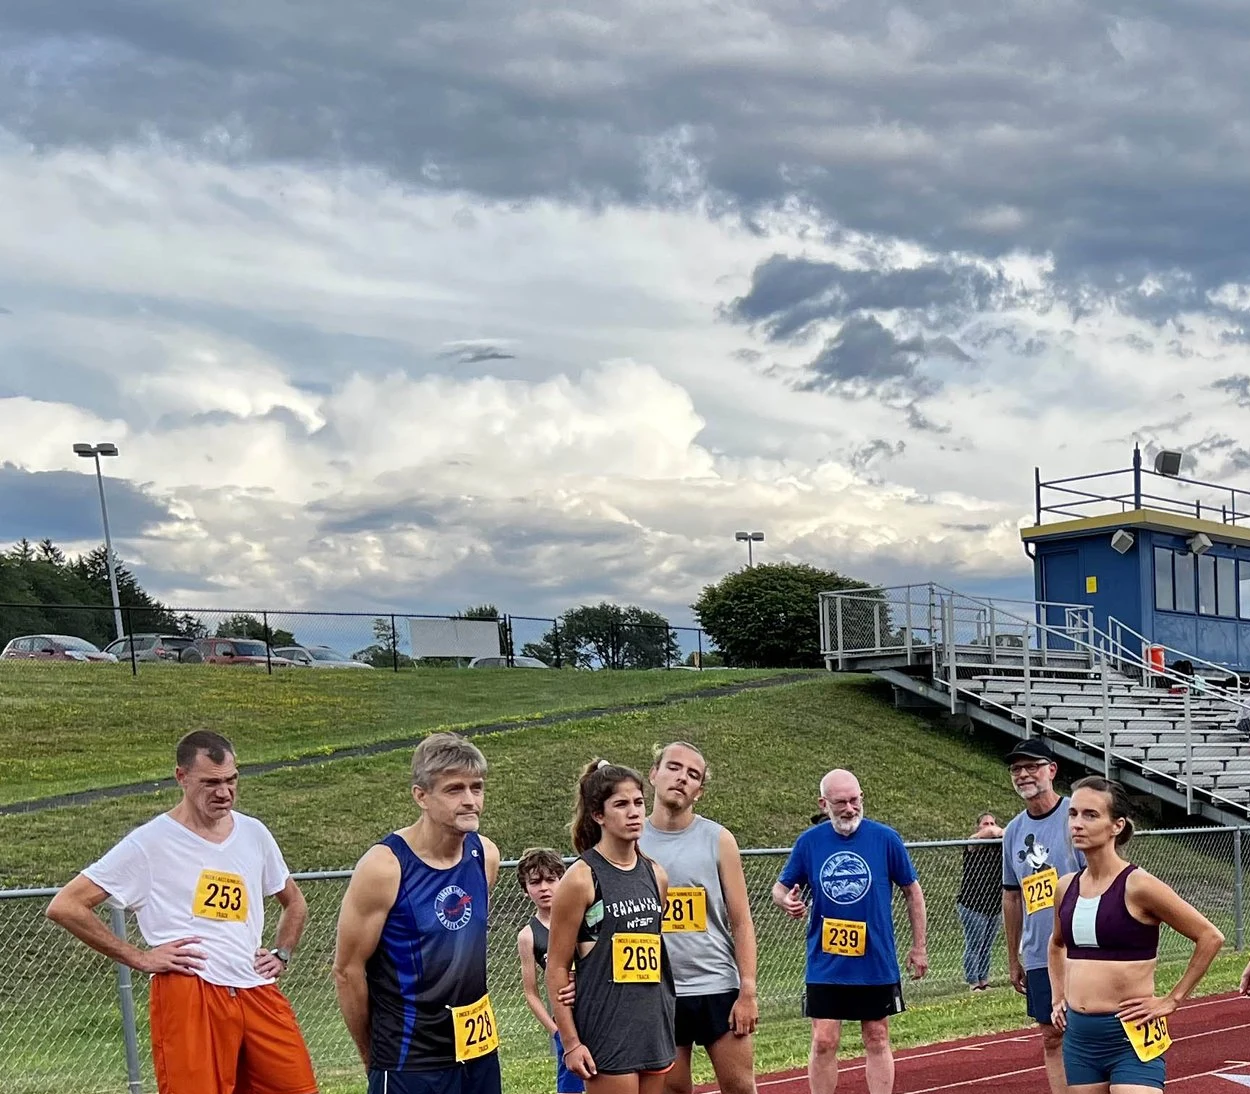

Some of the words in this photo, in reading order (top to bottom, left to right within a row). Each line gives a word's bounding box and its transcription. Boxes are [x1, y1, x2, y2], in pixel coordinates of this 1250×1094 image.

[204, 883, 242, 911] 253
[1028, 879, 1053, 904] 225
[606, 898, 635, 913] TRAIN
[662, 898, 694, 921] 281
[829, 927, 858, 948] 239
[623, 946, 658, 971] 266
[465, 1010, 492, 1046] 228
